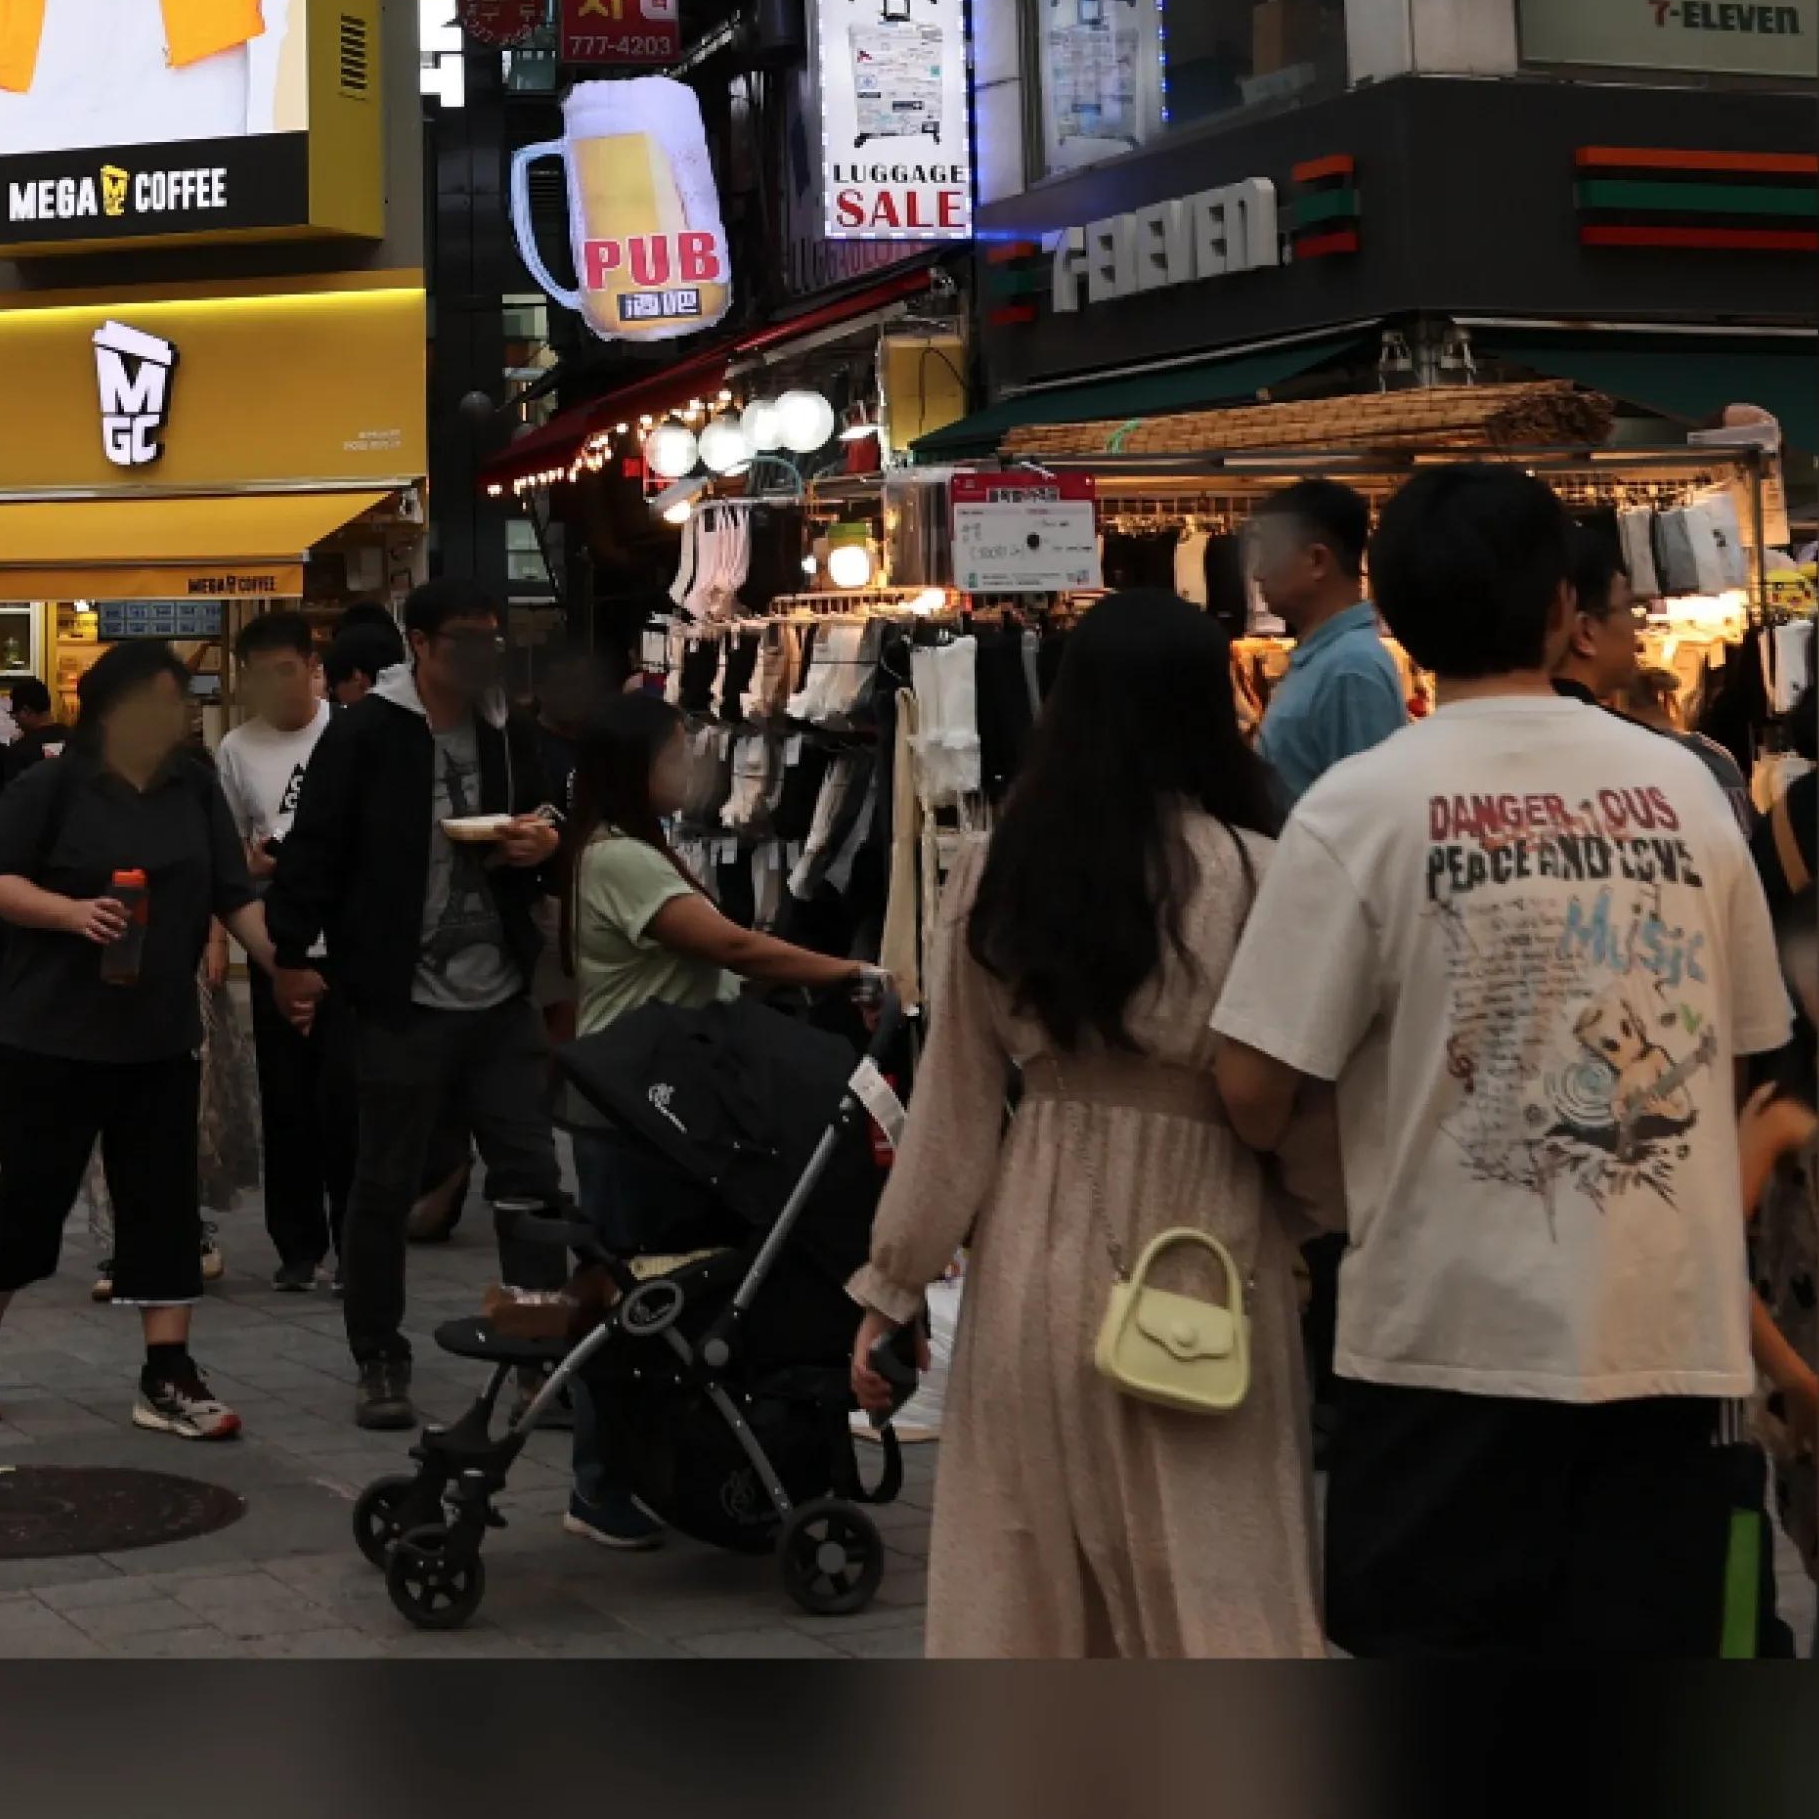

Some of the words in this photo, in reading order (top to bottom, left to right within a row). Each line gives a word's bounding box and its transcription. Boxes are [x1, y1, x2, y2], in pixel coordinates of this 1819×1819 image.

[568, 36, 672, 56] 777-4203
[8, 179, 96, 222] MEGA
[135, 167, 228, 213] COFFEE
[832, 163, 968, 184] LUGGAGE
[835, 188, 965, 229] SALE
[584, 231, 720, 290] PUB
[96, 348, 167, 414] M
[101, 414, 162, 466] GC
